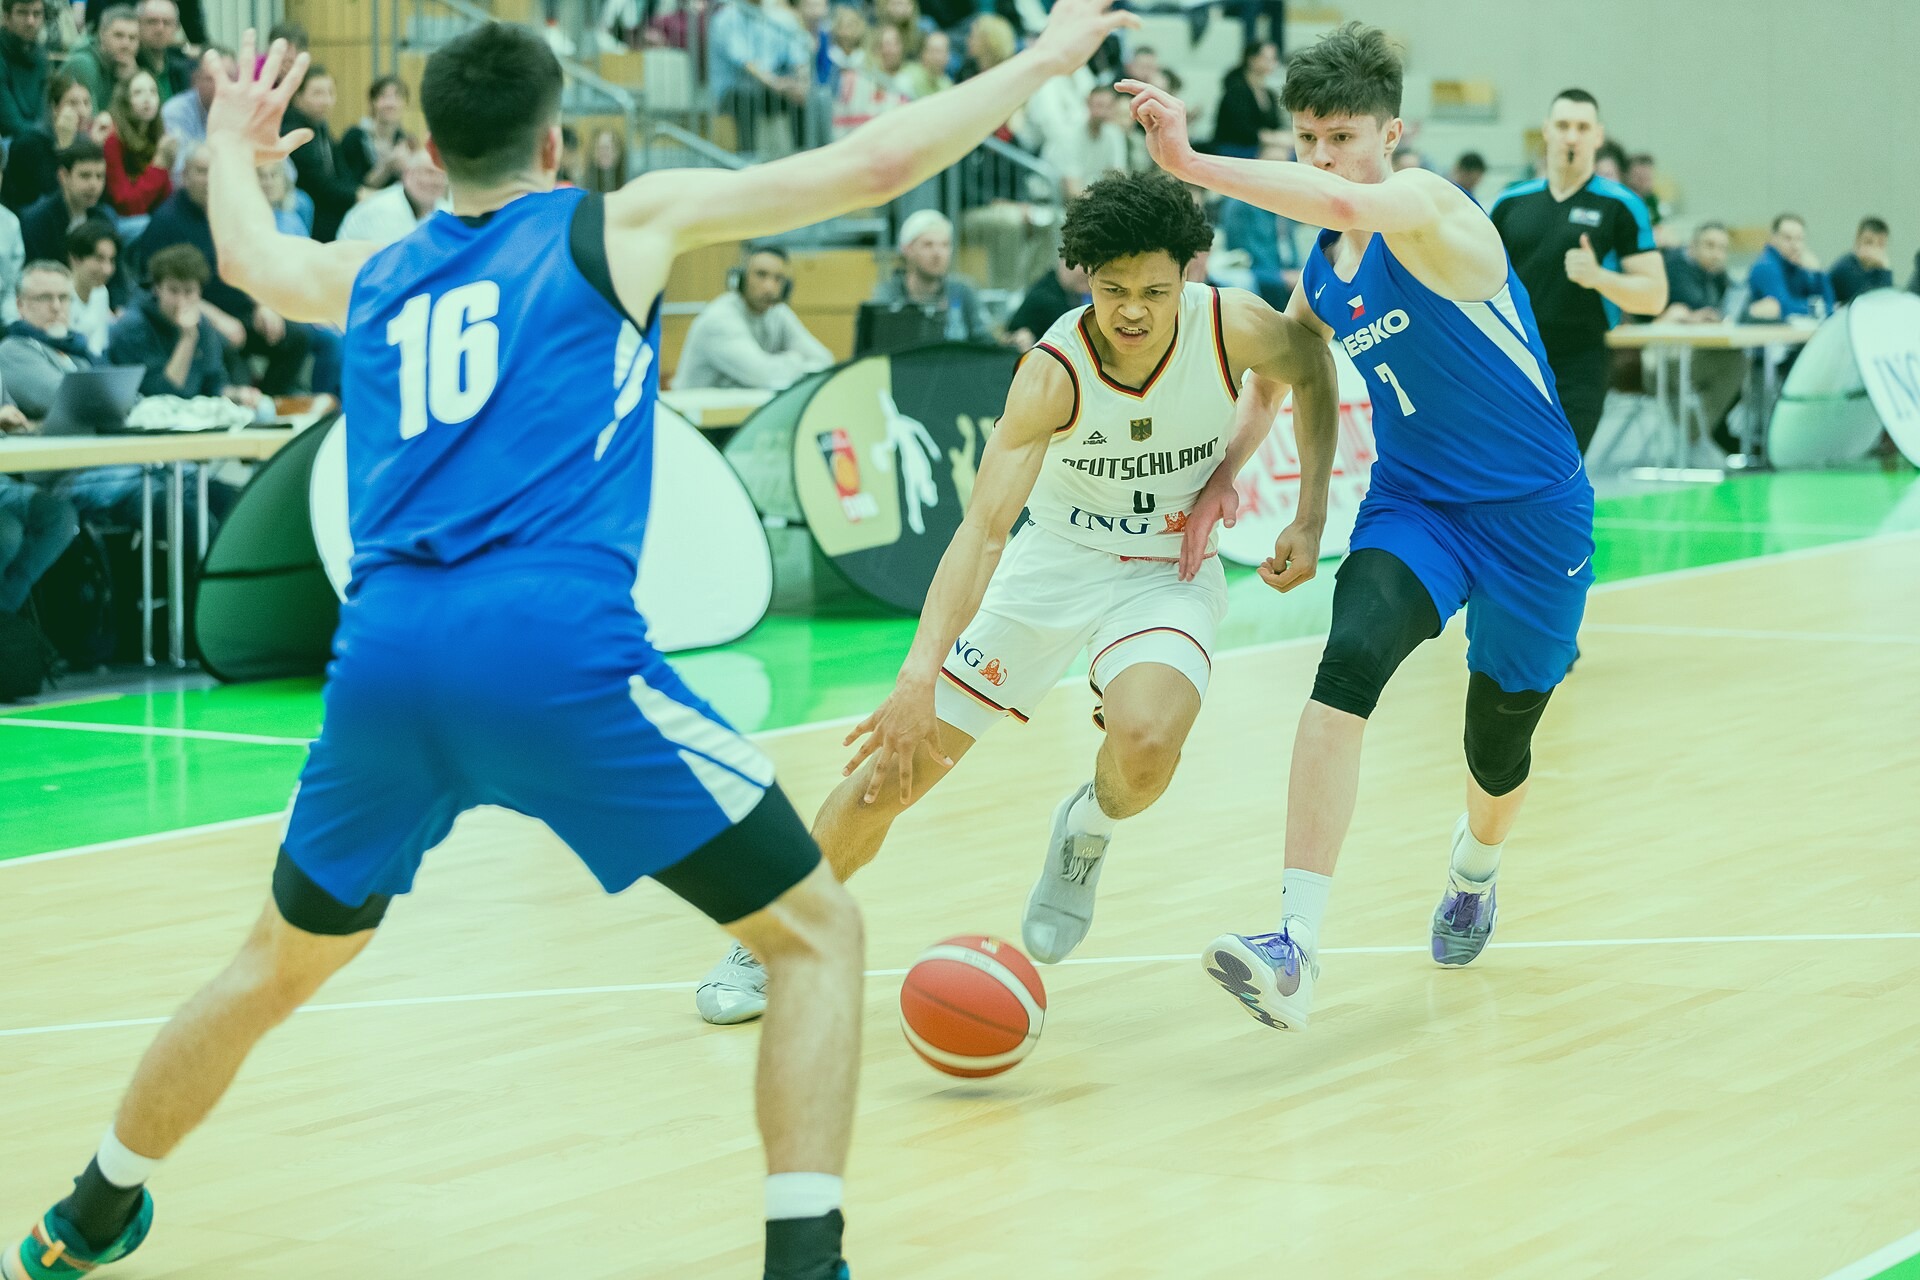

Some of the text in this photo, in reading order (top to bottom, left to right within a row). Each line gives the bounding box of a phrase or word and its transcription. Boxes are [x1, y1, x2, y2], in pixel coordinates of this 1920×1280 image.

[1340, 308, 1410, 358] ESKO
[386, 279, 500, 440] 16
[1373, 362, 1417, 417] 7
[955, 637, 984, 668] NG
